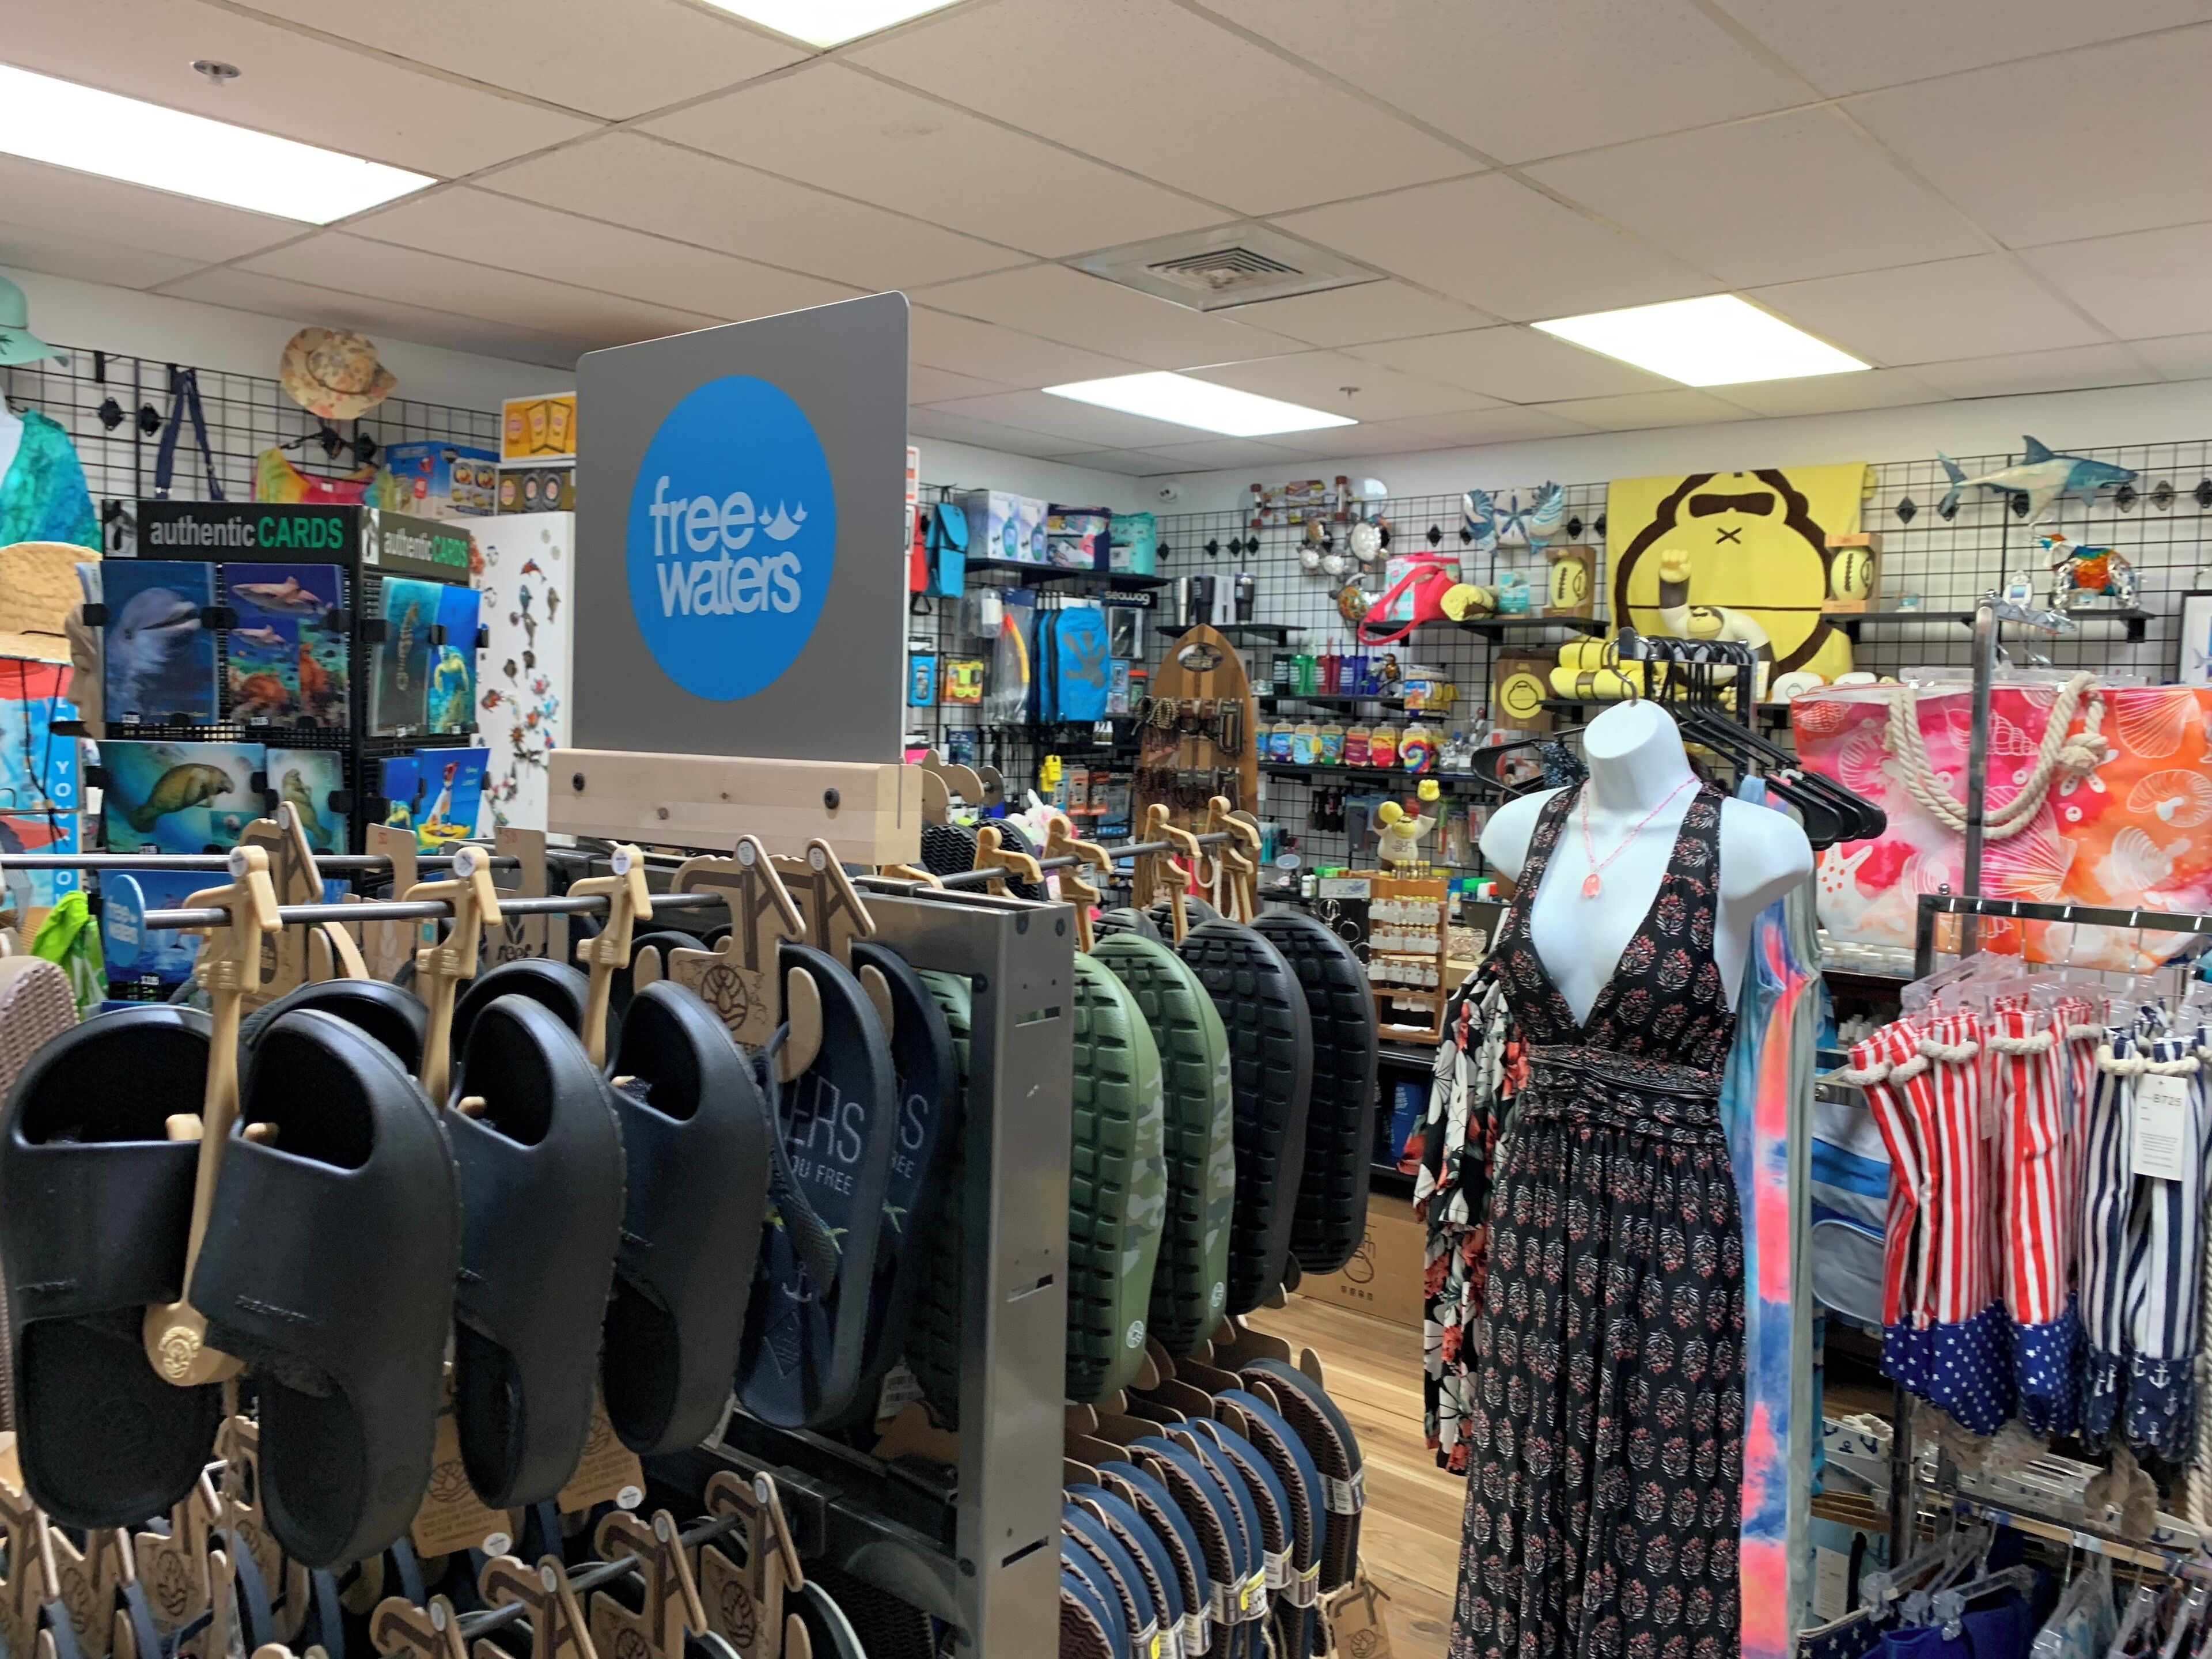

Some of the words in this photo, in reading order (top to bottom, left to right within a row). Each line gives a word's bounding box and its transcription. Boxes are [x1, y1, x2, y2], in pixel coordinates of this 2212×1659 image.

[649, 475, 755, 556] free
[656, 545, 802, 617] waters
[816, 1164, 854, 1195] FREE
